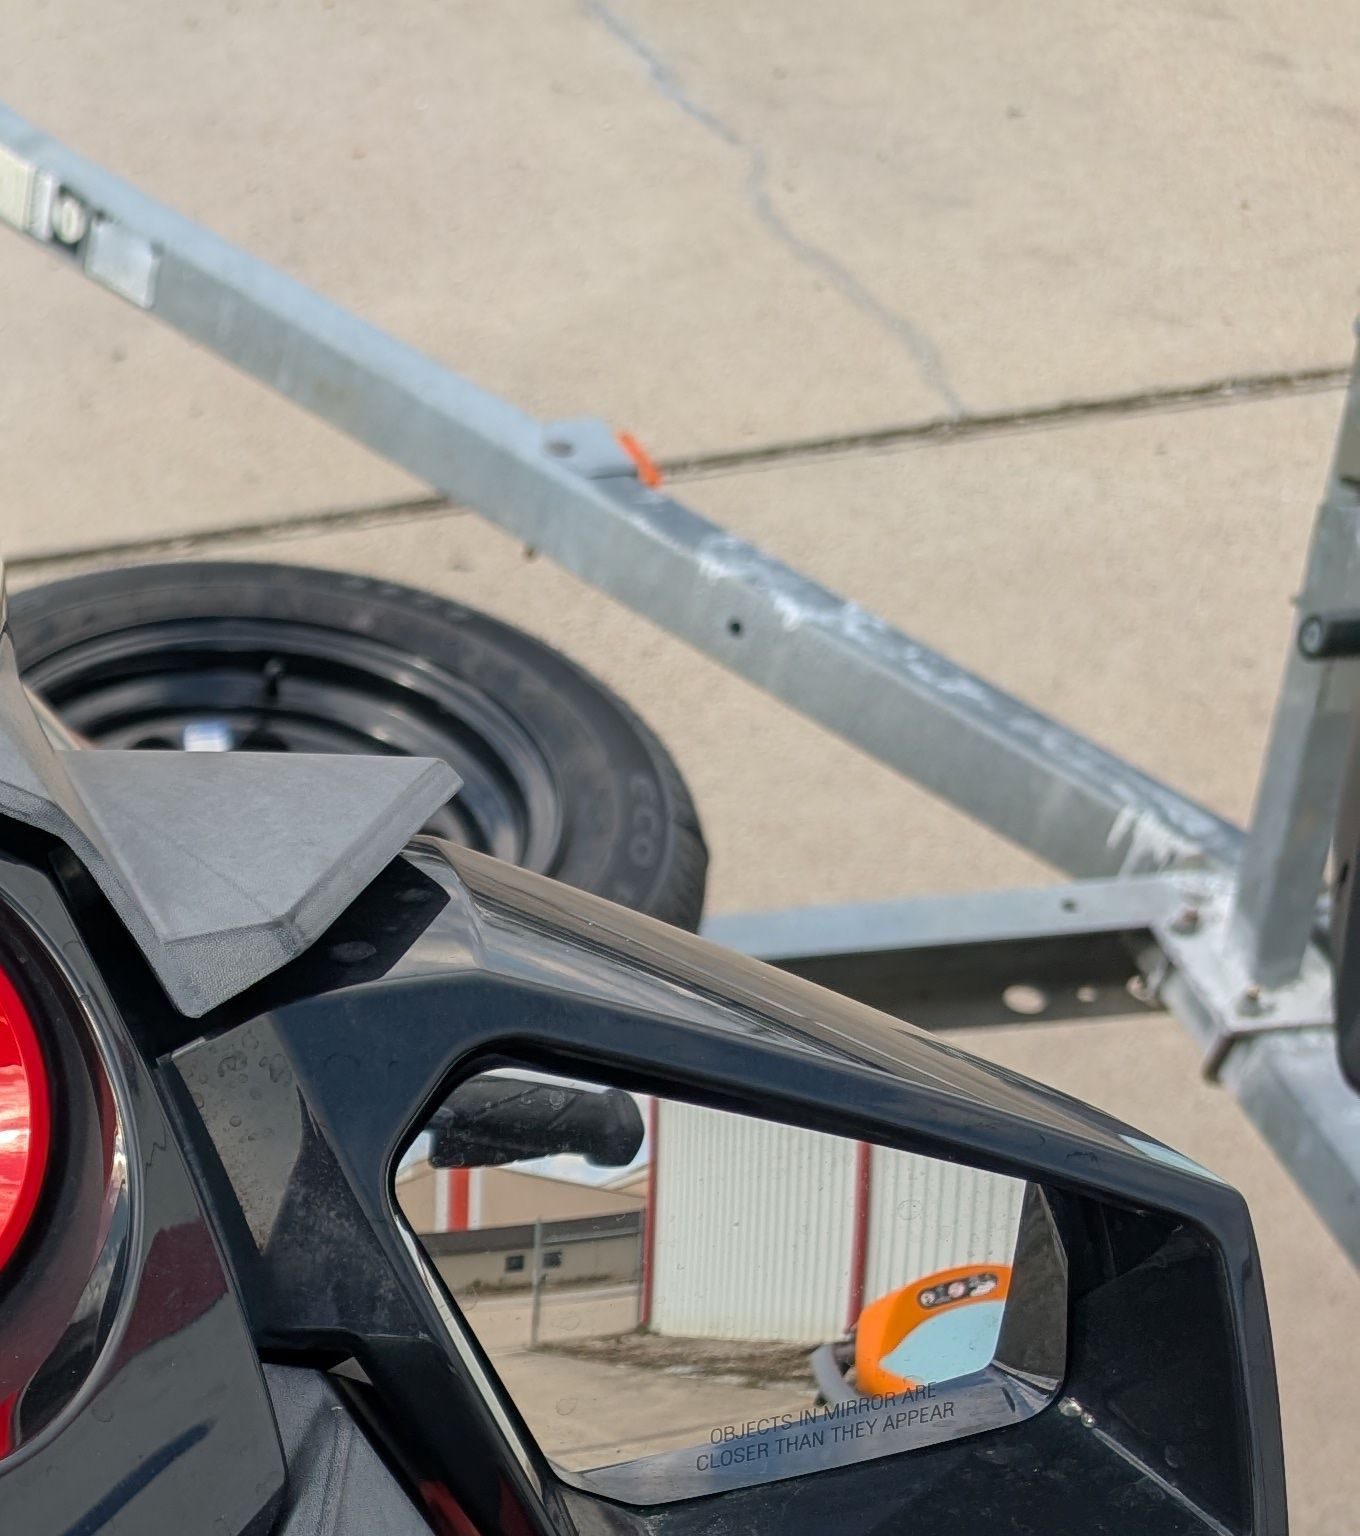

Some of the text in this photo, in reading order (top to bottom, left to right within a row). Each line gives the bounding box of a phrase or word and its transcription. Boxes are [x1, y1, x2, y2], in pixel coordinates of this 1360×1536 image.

[696, 1401, 955, 1471] CLOSER THAN THEY APPEAR
[710, 1381, 937, 1444] OBJECTS IN MIRROR ARE
